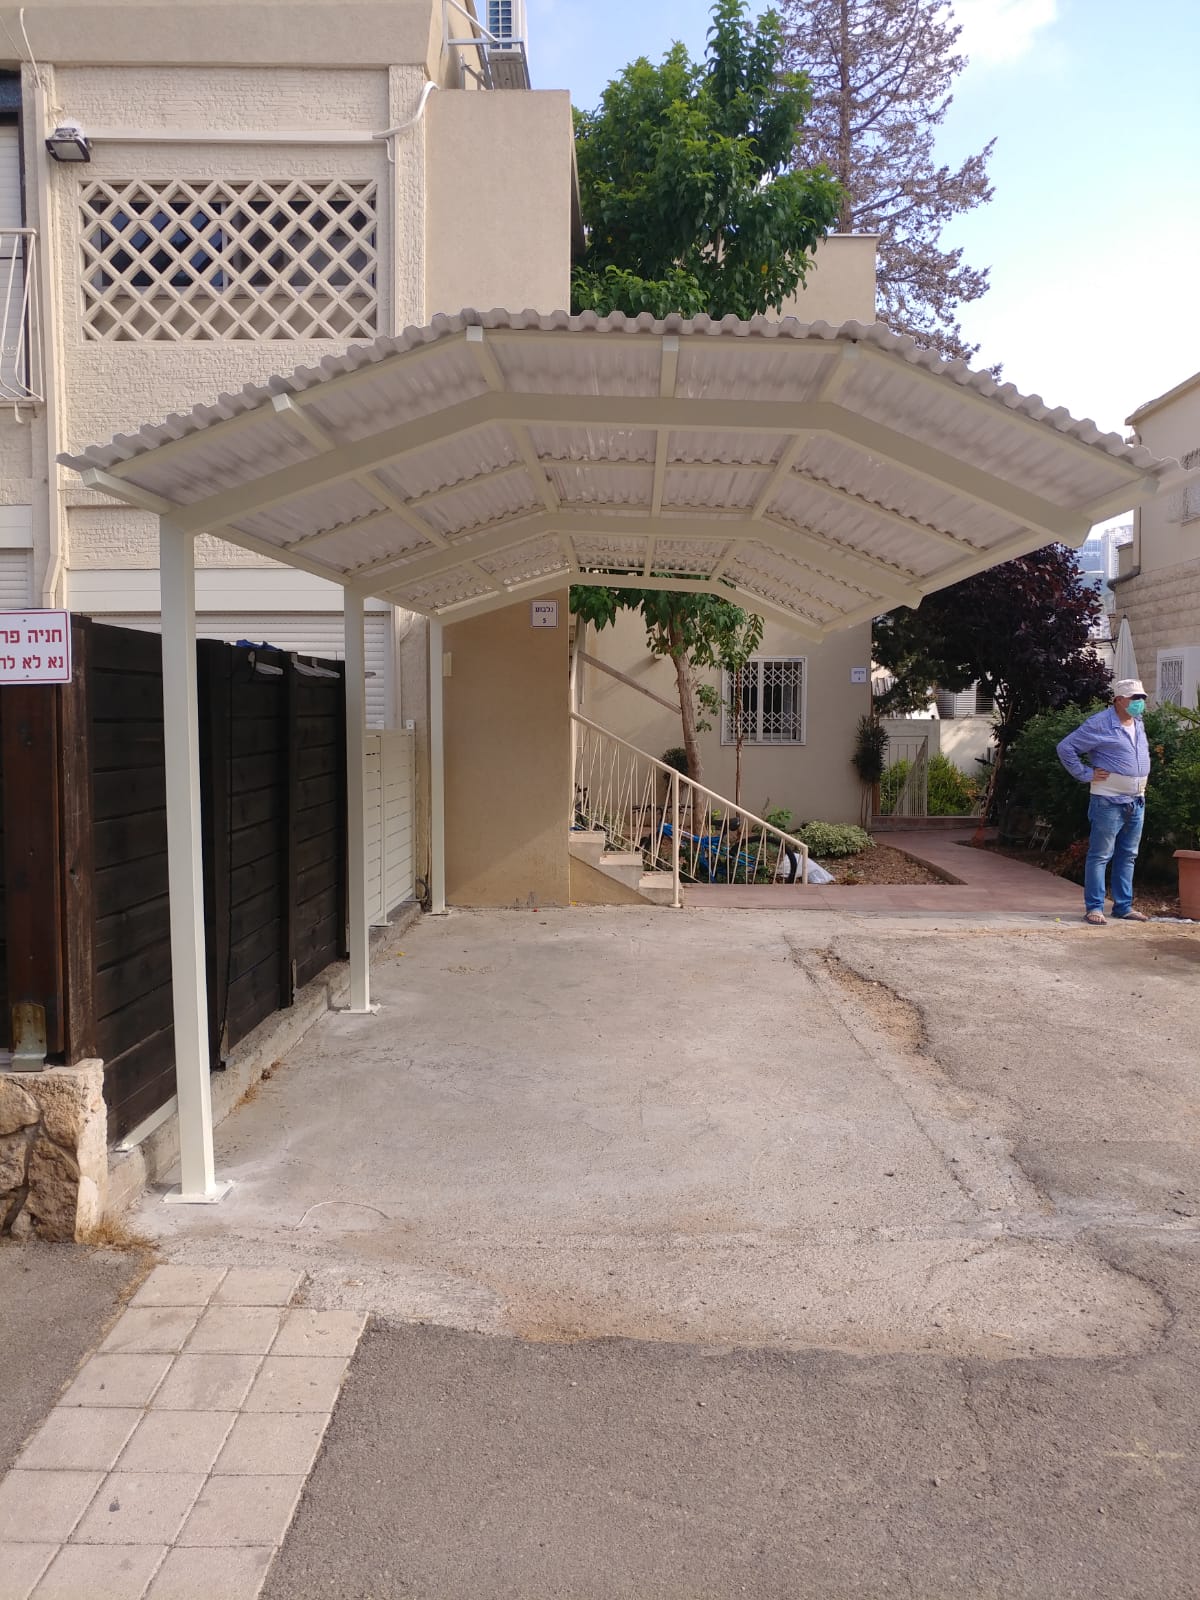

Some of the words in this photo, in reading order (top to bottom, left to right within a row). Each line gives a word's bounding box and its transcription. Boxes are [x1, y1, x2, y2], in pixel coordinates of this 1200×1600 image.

[28, 629, 62, 643] חניה
[22, 654, 41, 669] לא
[48, 656, 63, 669] נא
